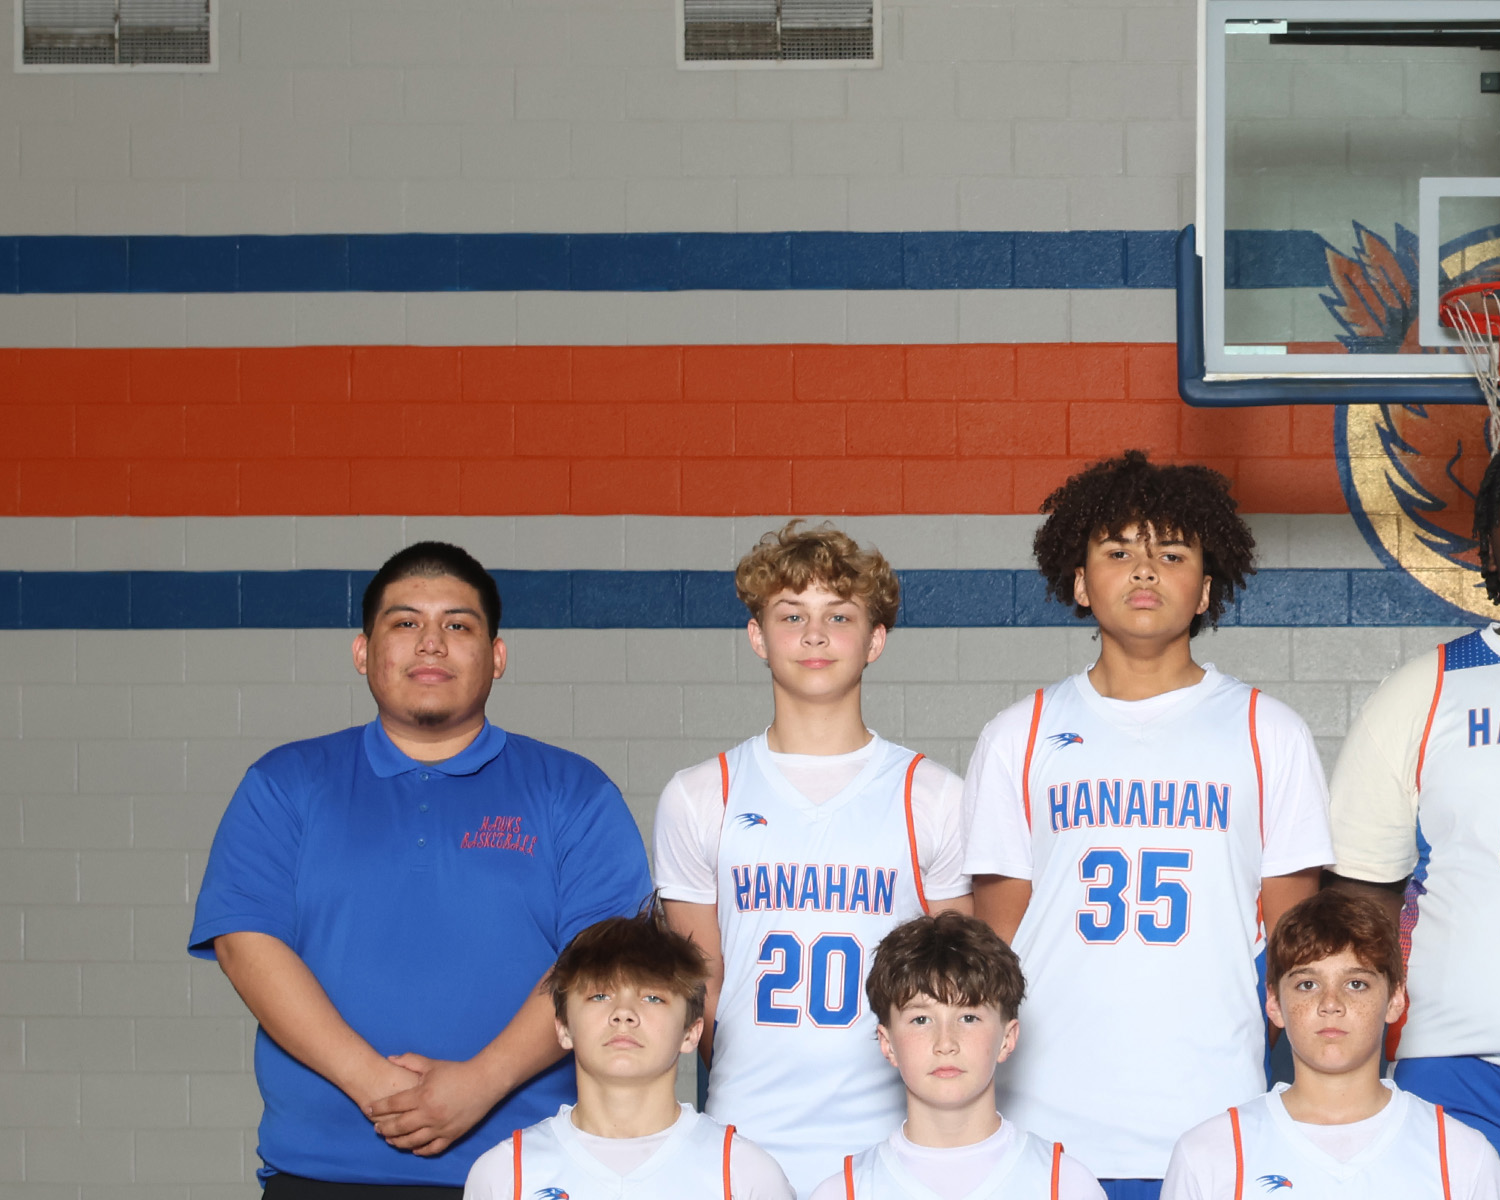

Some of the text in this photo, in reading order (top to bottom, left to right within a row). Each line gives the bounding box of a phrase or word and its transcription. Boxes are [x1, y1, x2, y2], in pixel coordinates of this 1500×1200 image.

[479, 815, 522, 834] HAWKS
[1048, 778, 1232, 834] HANAHAN
[460, 831, 538, 857] BASKETBALL
[732, 862, 898, 916] HANAHAN
[1075, 846, 1193, 947] 35
[754, 931, 864, 1029] 20
